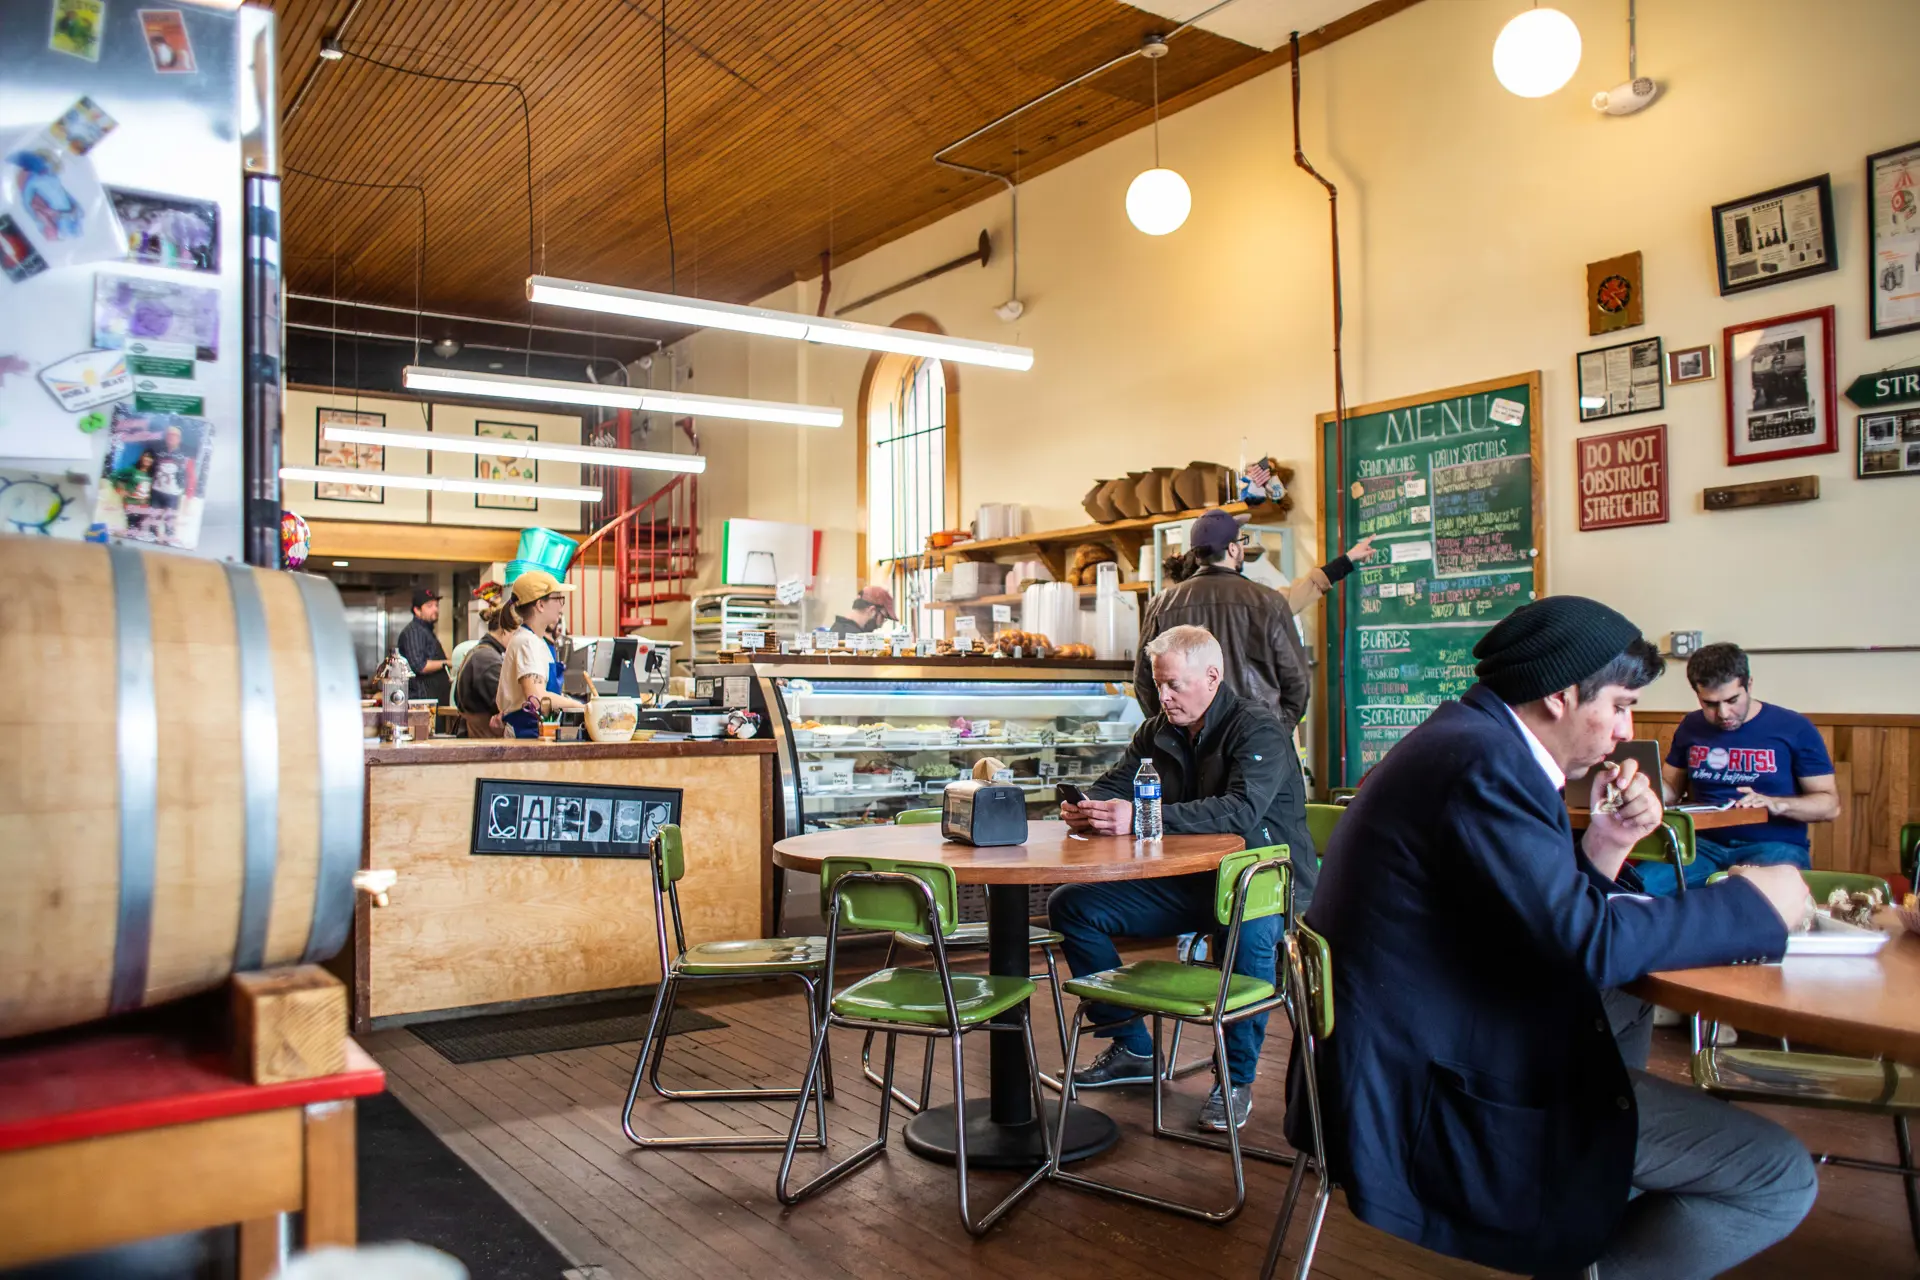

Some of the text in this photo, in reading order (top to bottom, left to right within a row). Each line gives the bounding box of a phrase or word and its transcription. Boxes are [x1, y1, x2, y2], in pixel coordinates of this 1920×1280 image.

[1385, 395, 1489, 447] MENU
[1435, 439, 1507, 468] DAILY SPECIALS
[1586, 435, 1656, 468] DO NOT
[1357, 455, 1417, 478] SANDWICHES
[1583, 462, 1660, 496] OBSTRUCT
[1584, 489, 1660, 523] STRETCHER
[1360, 630, 1410, 649] BOARDS
[1361, 653, 1384, 669] MEAT
[1360, 709, 1392, 726] SODA
